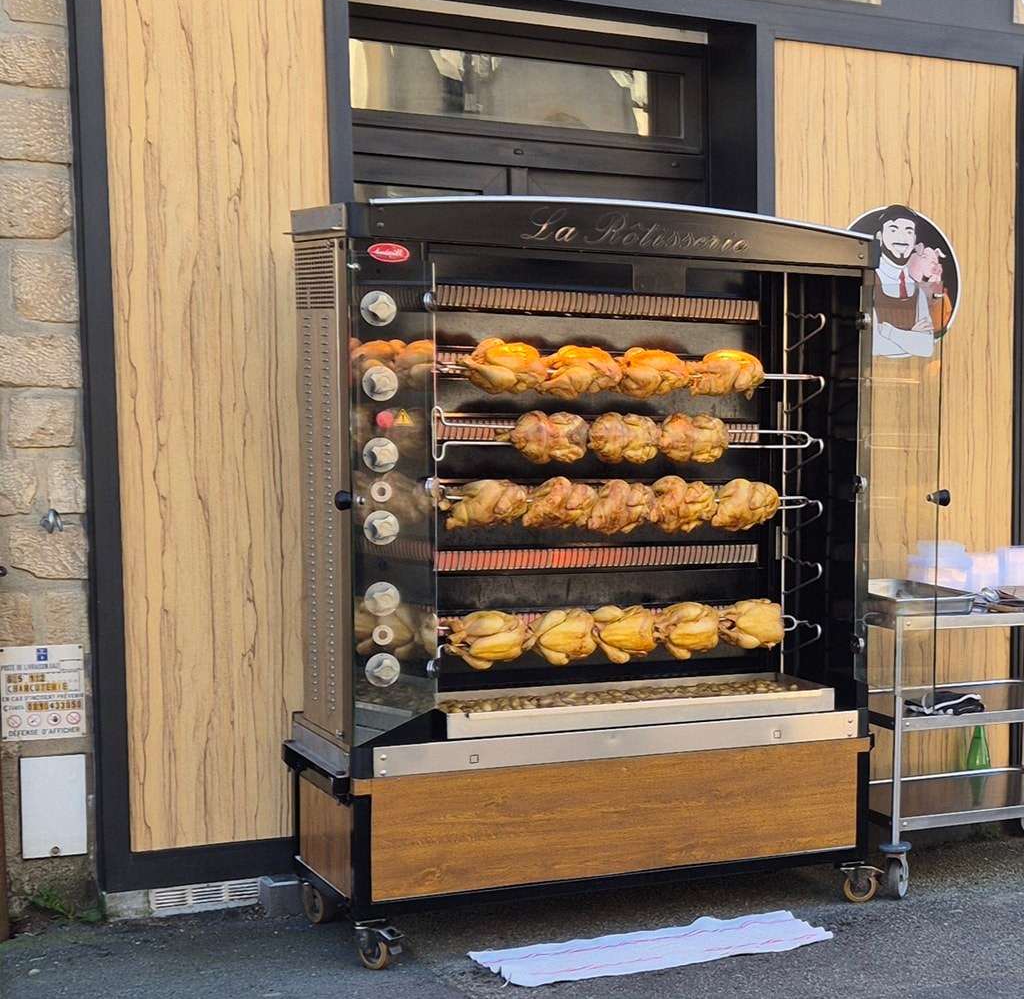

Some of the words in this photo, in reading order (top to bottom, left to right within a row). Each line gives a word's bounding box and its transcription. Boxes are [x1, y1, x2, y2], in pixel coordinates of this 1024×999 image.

[520, 206, 577, 243] La
[584, 211, 749, 253] Rôtisserie
[8, 728, 38, 737] DÉFENSE
[41, 726, 80, 736] D'AFFICHER
